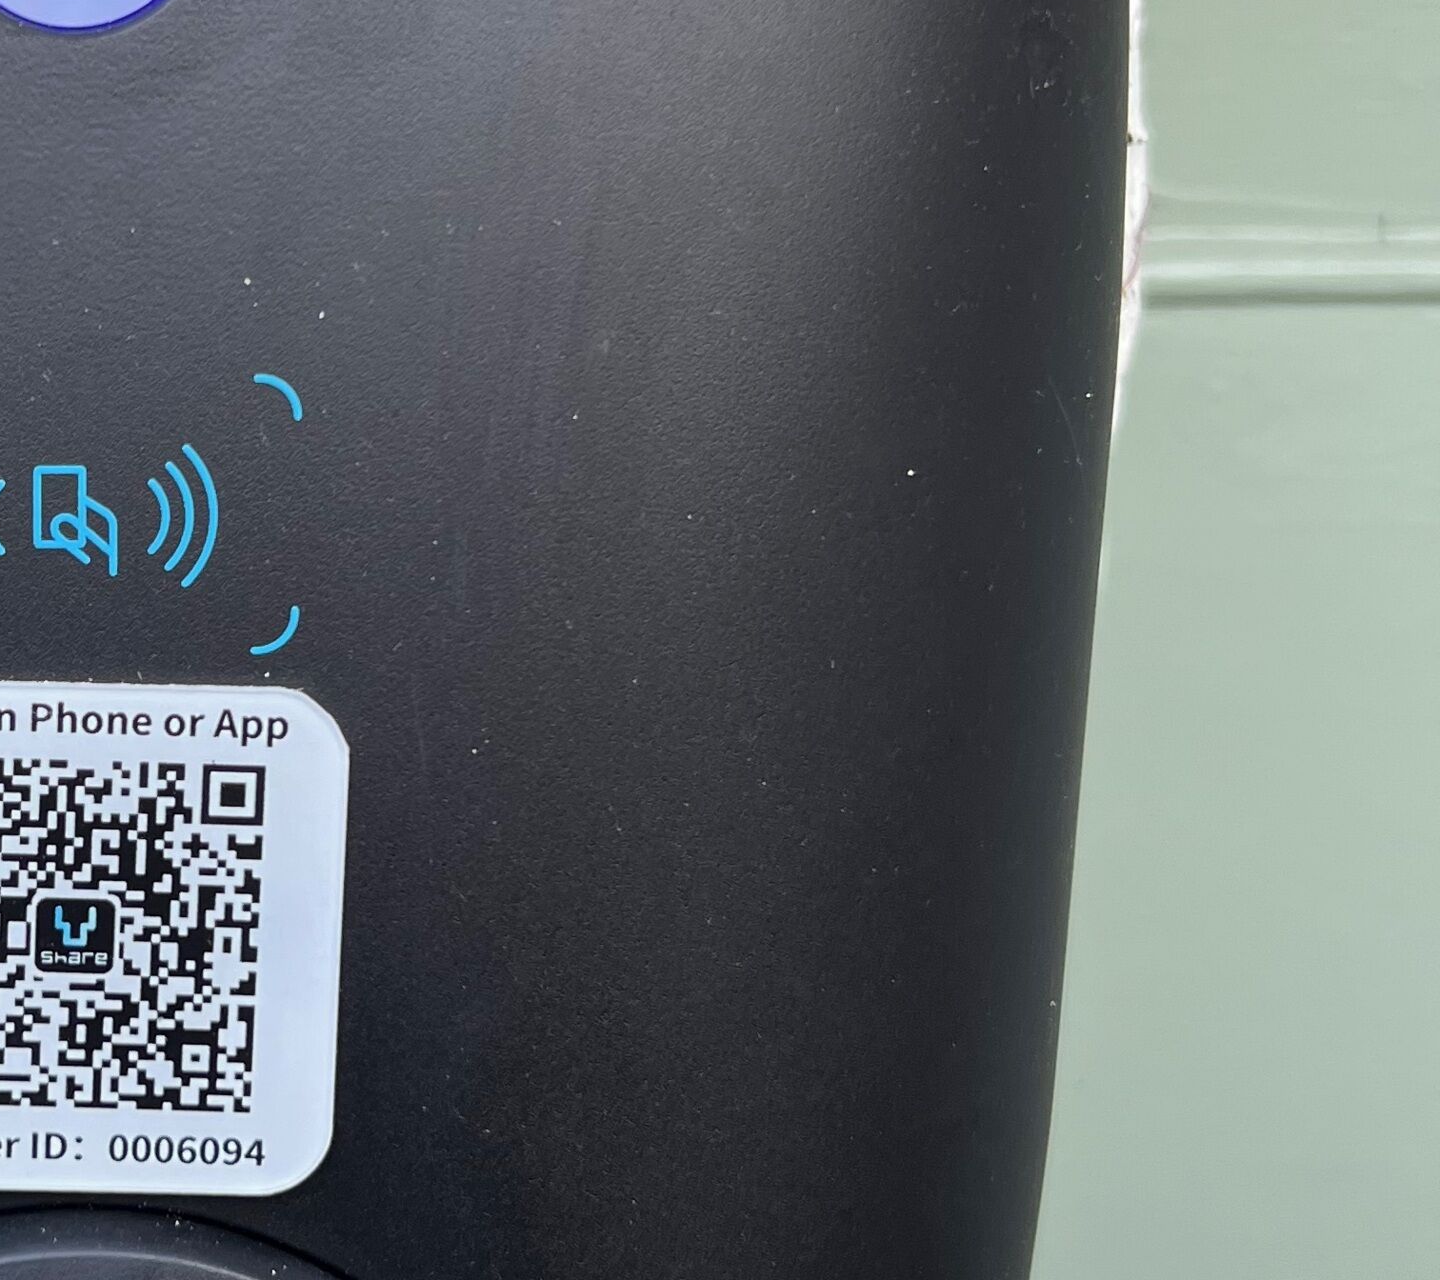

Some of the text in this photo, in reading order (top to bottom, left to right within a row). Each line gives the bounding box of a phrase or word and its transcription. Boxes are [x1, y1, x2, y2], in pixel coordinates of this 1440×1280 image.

[30, 702, 153, 736] Phone
[163, 713, 206, 737] or
[213, 708, 289, 747] App
[31, 1134, 85, 1161] ID:
[108, 1135, 266, 1167] 0006094
